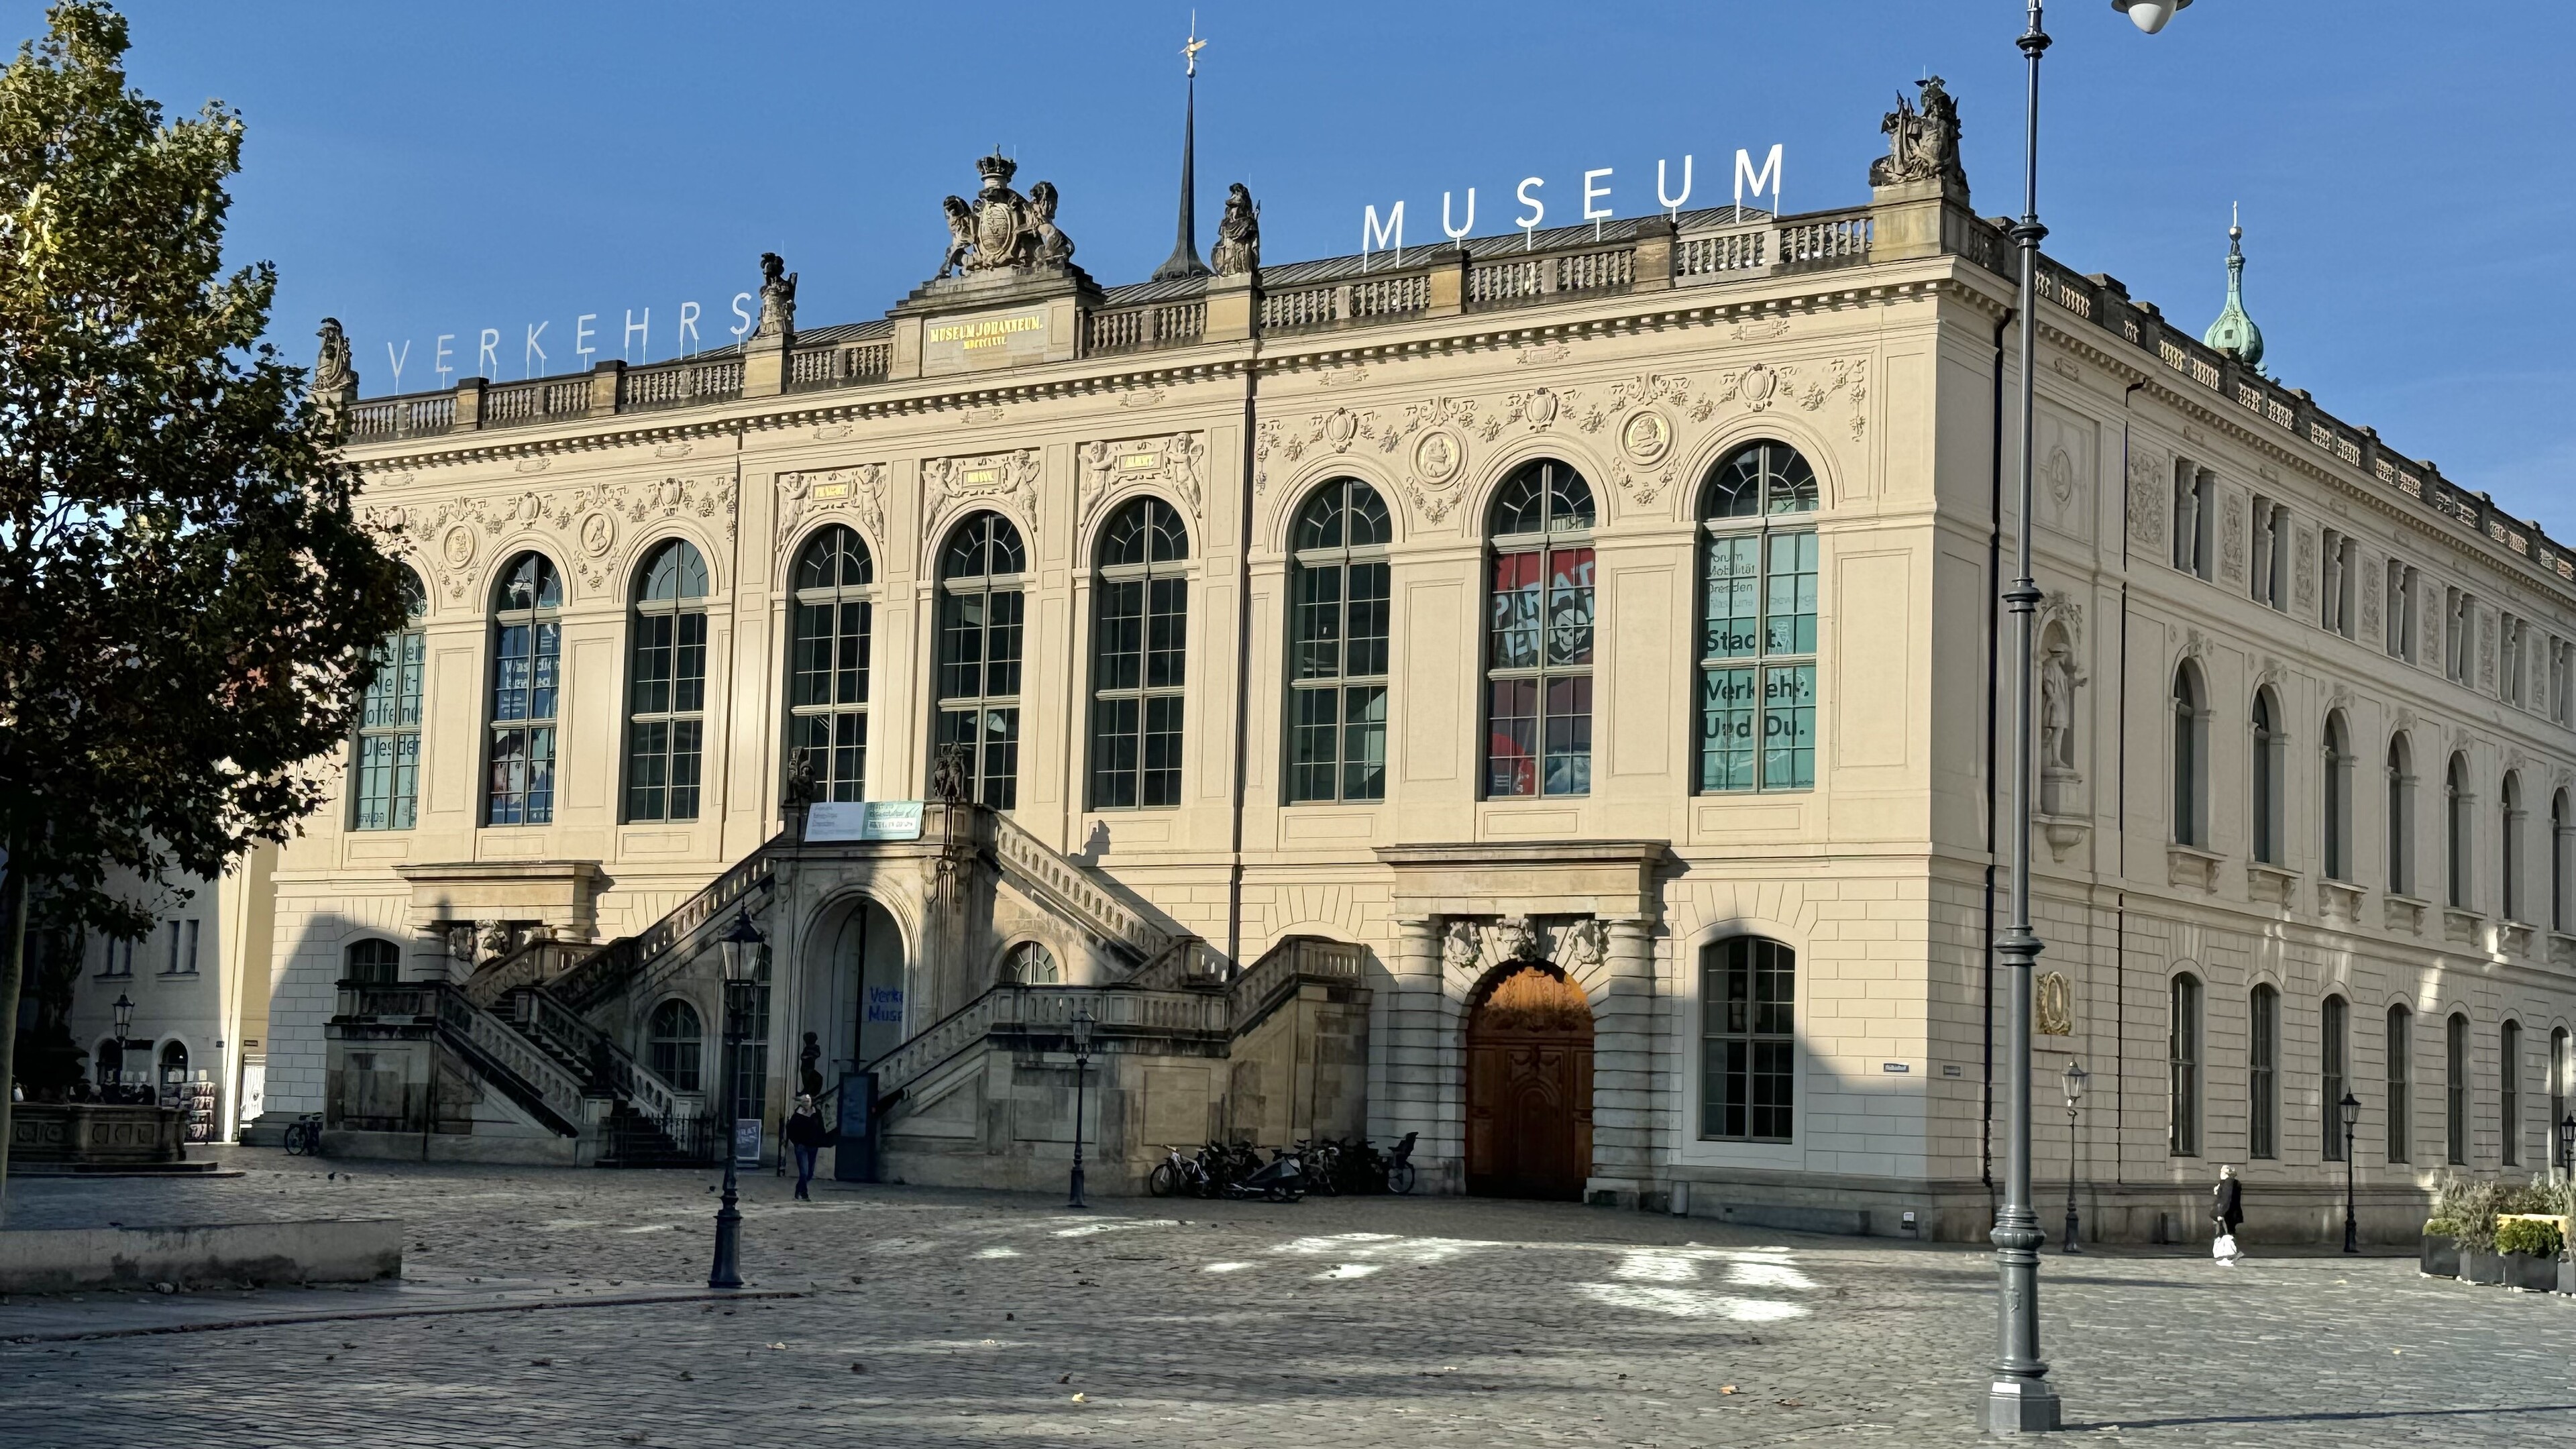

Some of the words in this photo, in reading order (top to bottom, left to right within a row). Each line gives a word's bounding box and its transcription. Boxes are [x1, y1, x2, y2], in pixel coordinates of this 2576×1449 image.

[387, 293, 752, 378] VERKEHRS
[1363, 144, 1783, 250] MUSEUM
[930, 324, 975, 342] MUSEUM
[1764, 715, 1805, 737] Du.
